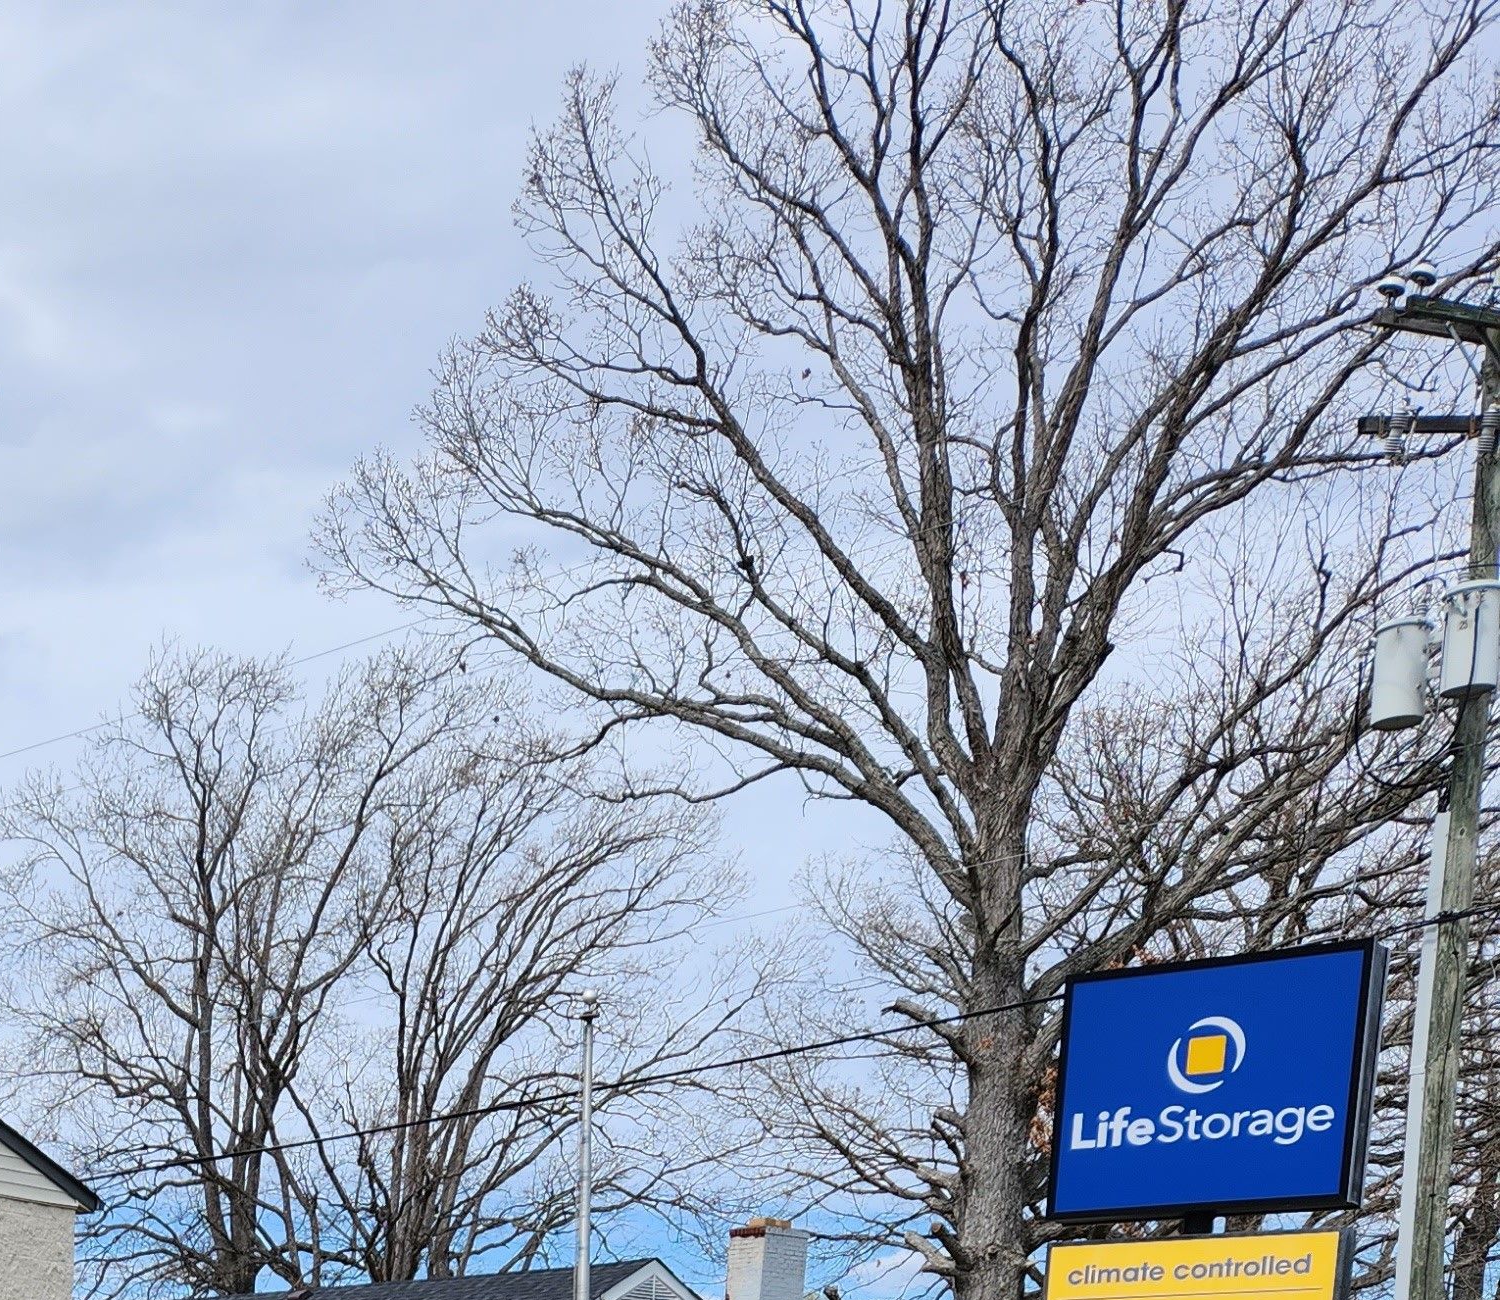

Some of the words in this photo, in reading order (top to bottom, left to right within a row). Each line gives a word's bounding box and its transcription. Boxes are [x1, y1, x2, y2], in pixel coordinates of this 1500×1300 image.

[1069, 1104, 1335, 1151] LifeStorage
[1068, 1262, 1164, 1285] climate
[1173, 1253, 1312, 1281] controlled
